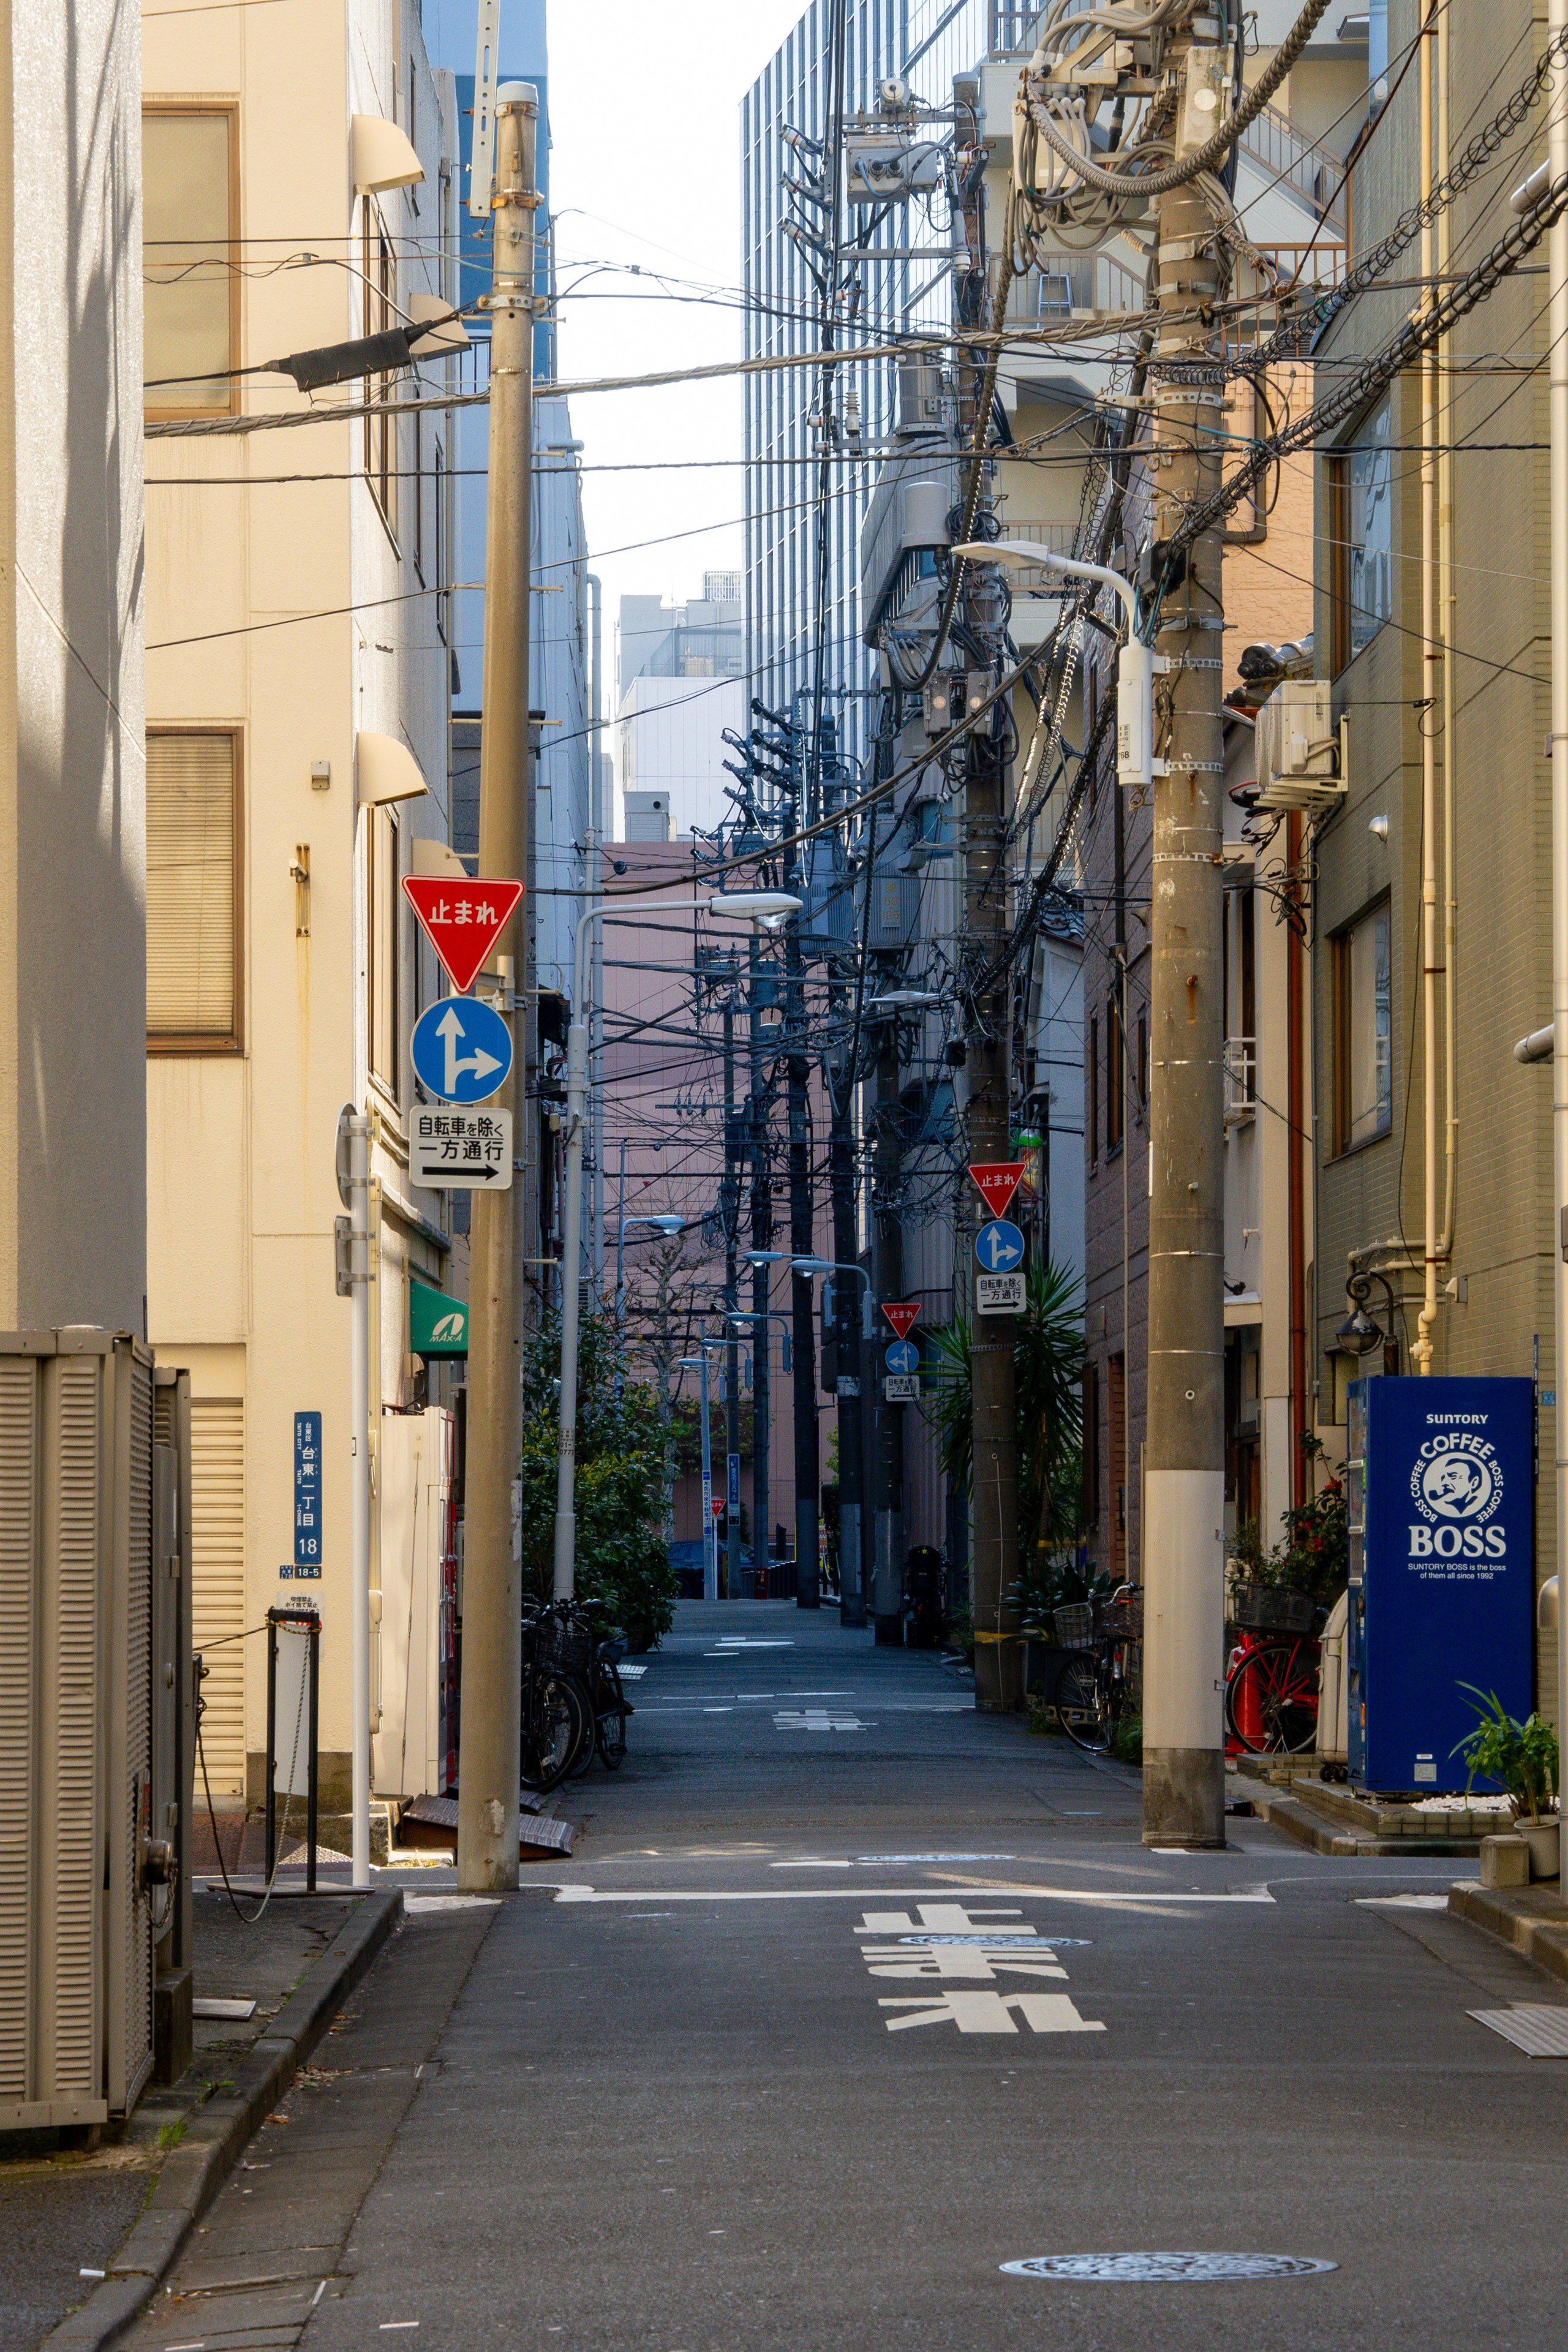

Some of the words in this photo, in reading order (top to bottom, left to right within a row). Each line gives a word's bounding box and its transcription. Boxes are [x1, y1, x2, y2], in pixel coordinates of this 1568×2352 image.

[428, 899, 499, 925] 止まれ
[419, 1115, 502, 1137] 自転車を除く
[419, 1139, 503, 1161] 一方通行
[981, 1174, 1016, 1187] 止まれ
[981, 1278, 1021, 1289] 自転車を除く
[981, 1289, 1022, 1300] 一方通行
[1426, 1414, 1488, 1424] SUNTORY
[1420, 1433, 1495, 1460] COFFEE
[302, 1446, 315, 1526] 台東一丁目
[1411, 1460, 1426, 1498] COFFEE
[1488, 1460, 1504, 1487] BOSS
[1415, 1499, 1438, 1523] BOSS
[1476, 1490, 1502, 1523] COFFEE
[300, 1539, 317, 1554] 18
[1408, 1526, 1506, 1557] BOSS
[854, 1904, 1107, 2033] 止まれ
